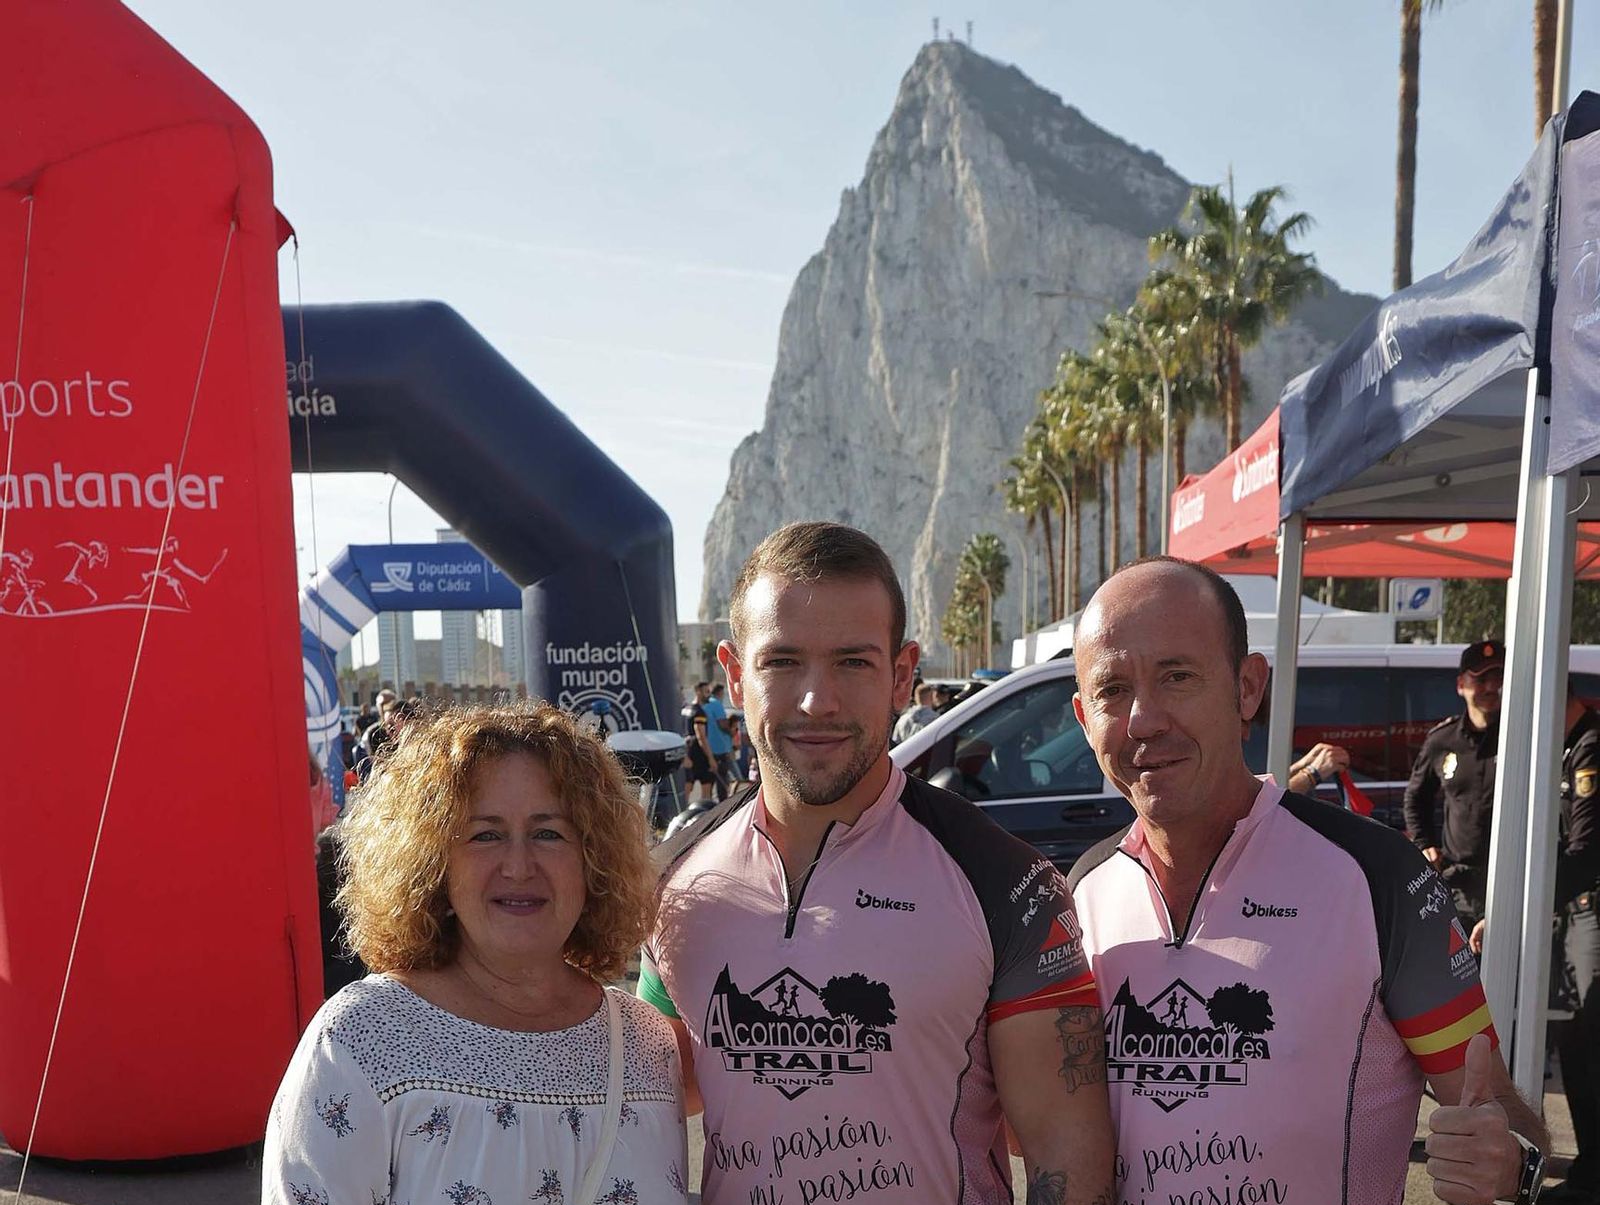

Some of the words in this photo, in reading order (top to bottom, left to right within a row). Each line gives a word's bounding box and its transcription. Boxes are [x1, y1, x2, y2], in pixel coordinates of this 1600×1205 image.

[416, 560, 481, 577] Diputación
[419, 580, 434, 593] de
[437, 578, 471, 592] Cádiz
[546, 640, 648, 664] fundación
[562, 664, 628, 690] mupol
[727, 1052, 866, 1071] TRAIL
[752, 1076, 834, 1086] RUNNING
[1108, 1063, 1242, 1083] TRAIL
[1131, 1088, 1209, 1098] RUNNING
